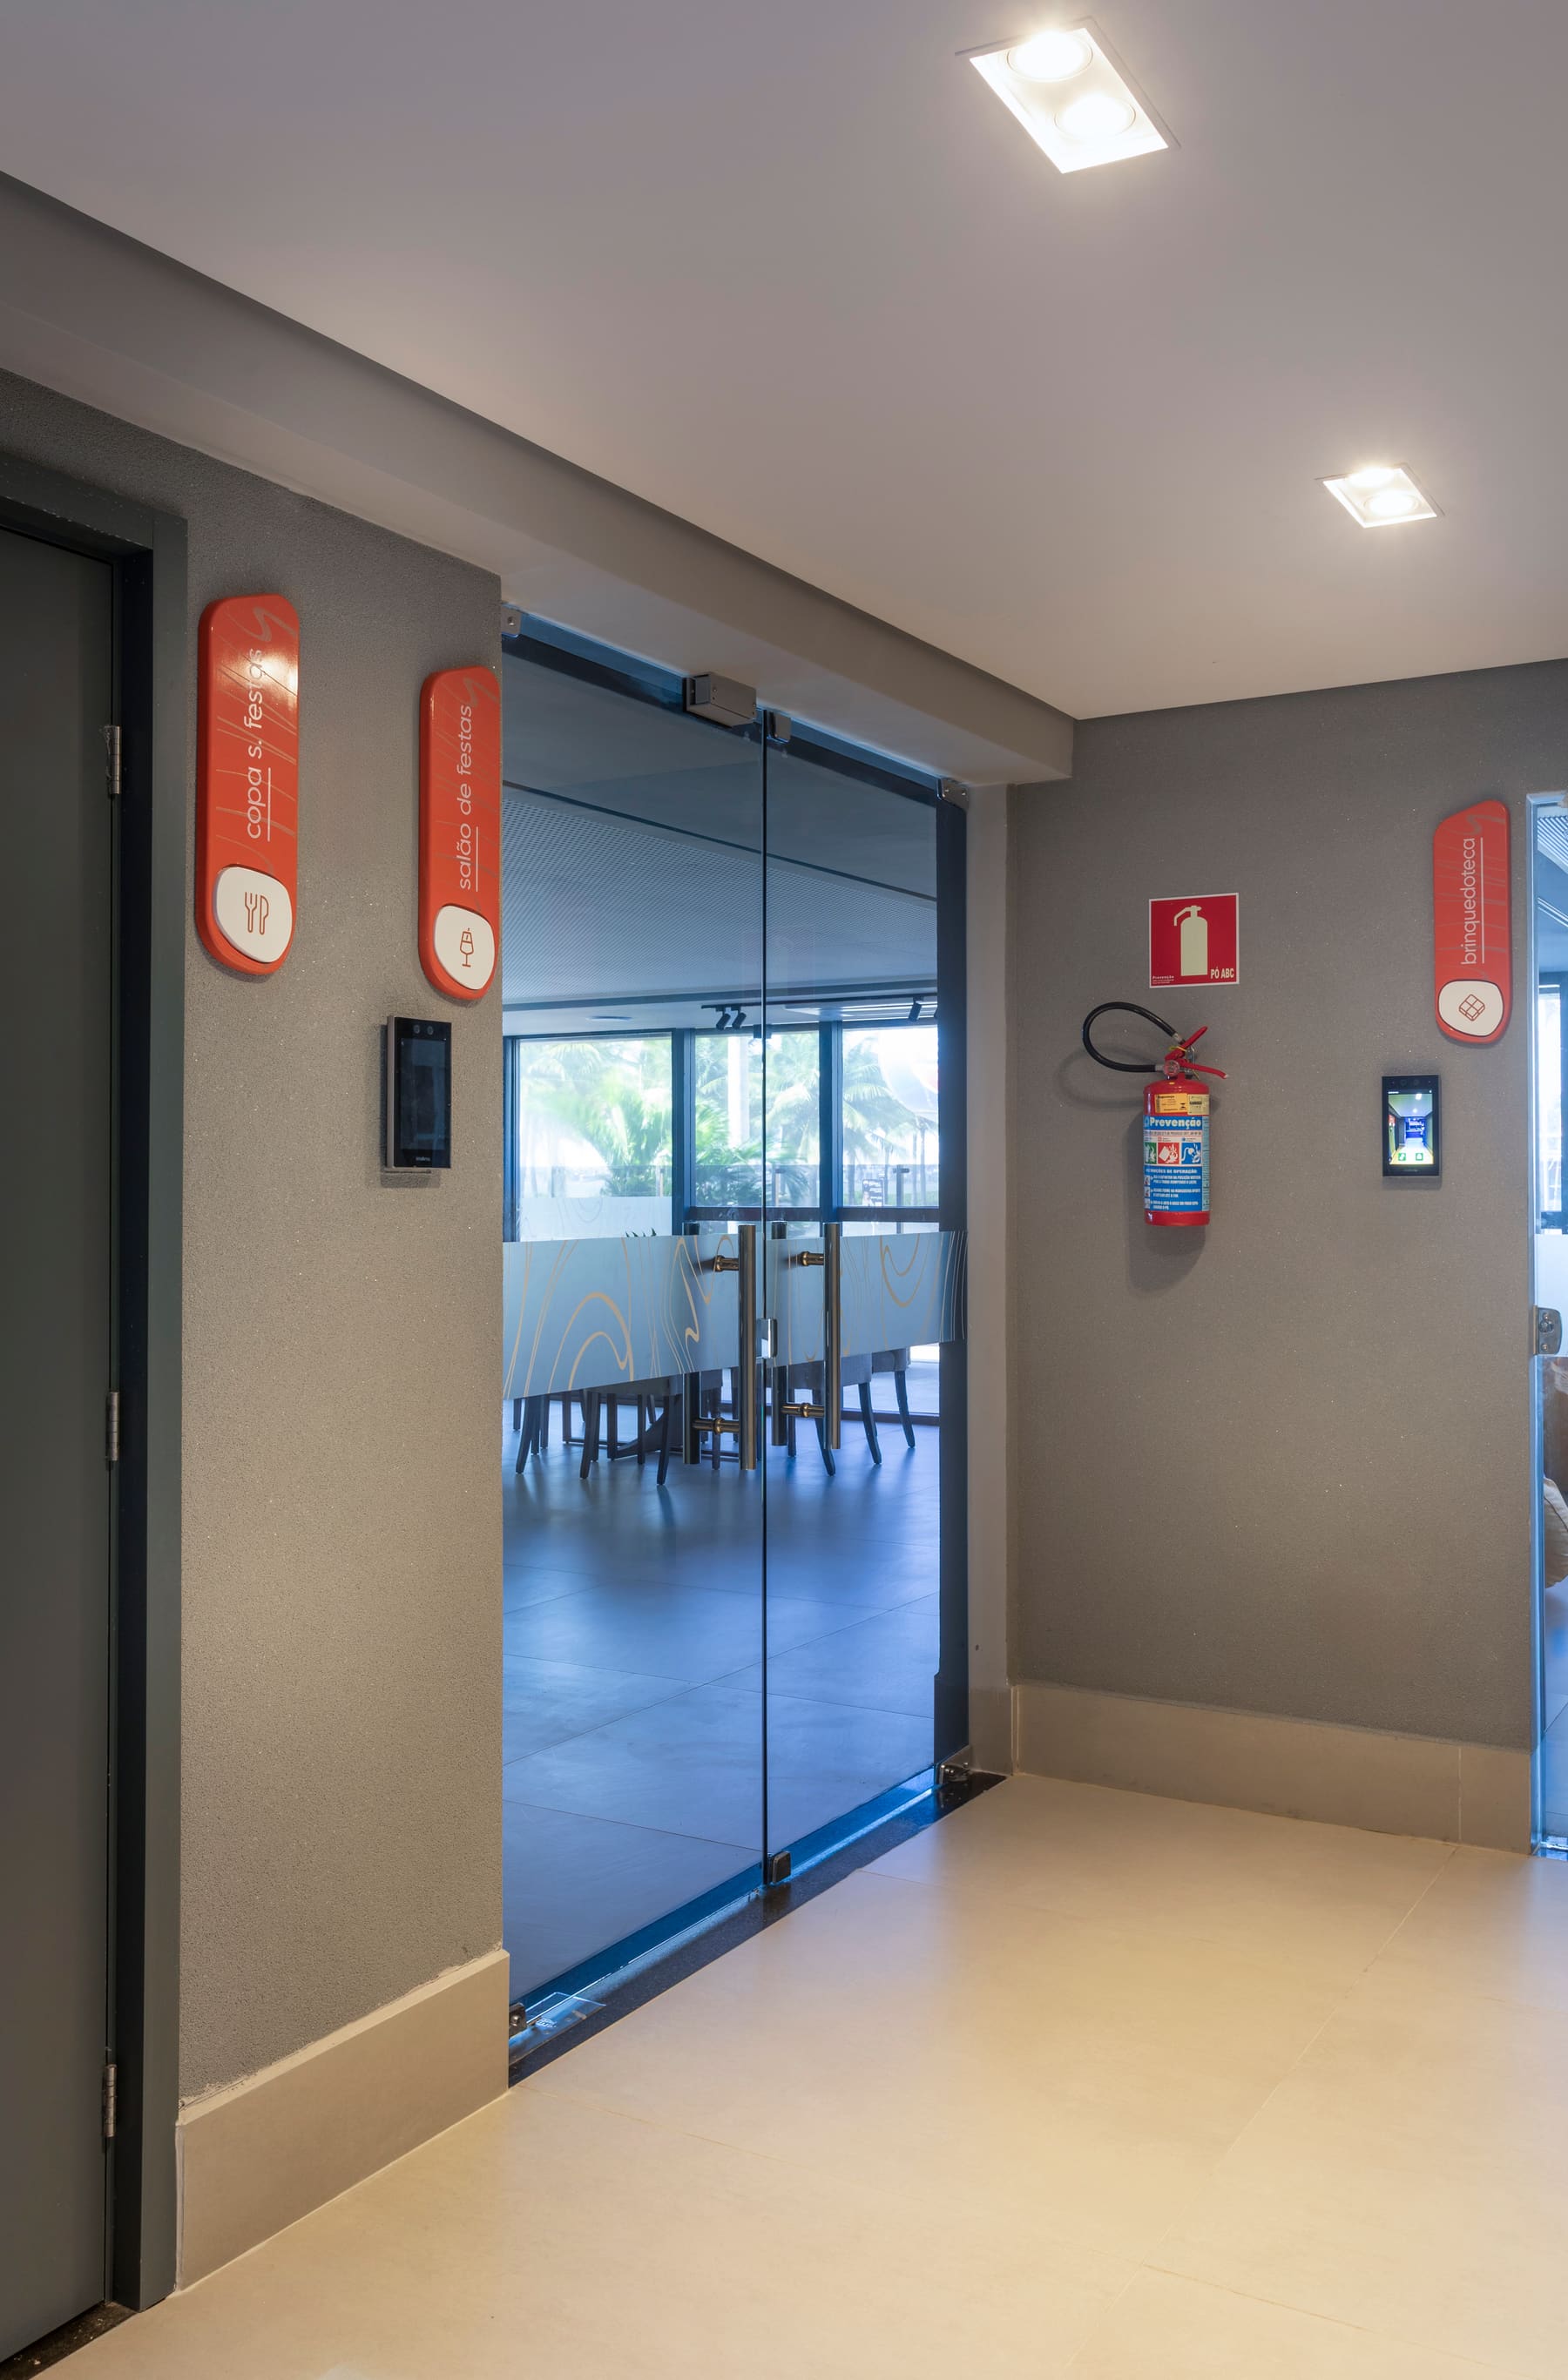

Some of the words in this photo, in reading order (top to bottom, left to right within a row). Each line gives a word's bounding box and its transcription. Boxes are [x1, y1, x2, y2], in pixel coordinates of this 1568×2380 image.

[244, 648, 263, 730] festas
[248, 740, 262, 759] s.
[456, 705, 472, 775] festas
[247, 766, 266, 839] copa
[456, 783, 472, 816] de
[456, 823, 471, 891] salão
[1460, 837, 1479, 965] brinquedoteca
[1210, 967, 1219, 979] PÓ
[1220, 968, 1234, 979] ABC
[1150, 1117, 1201, 1129] Prevenção
